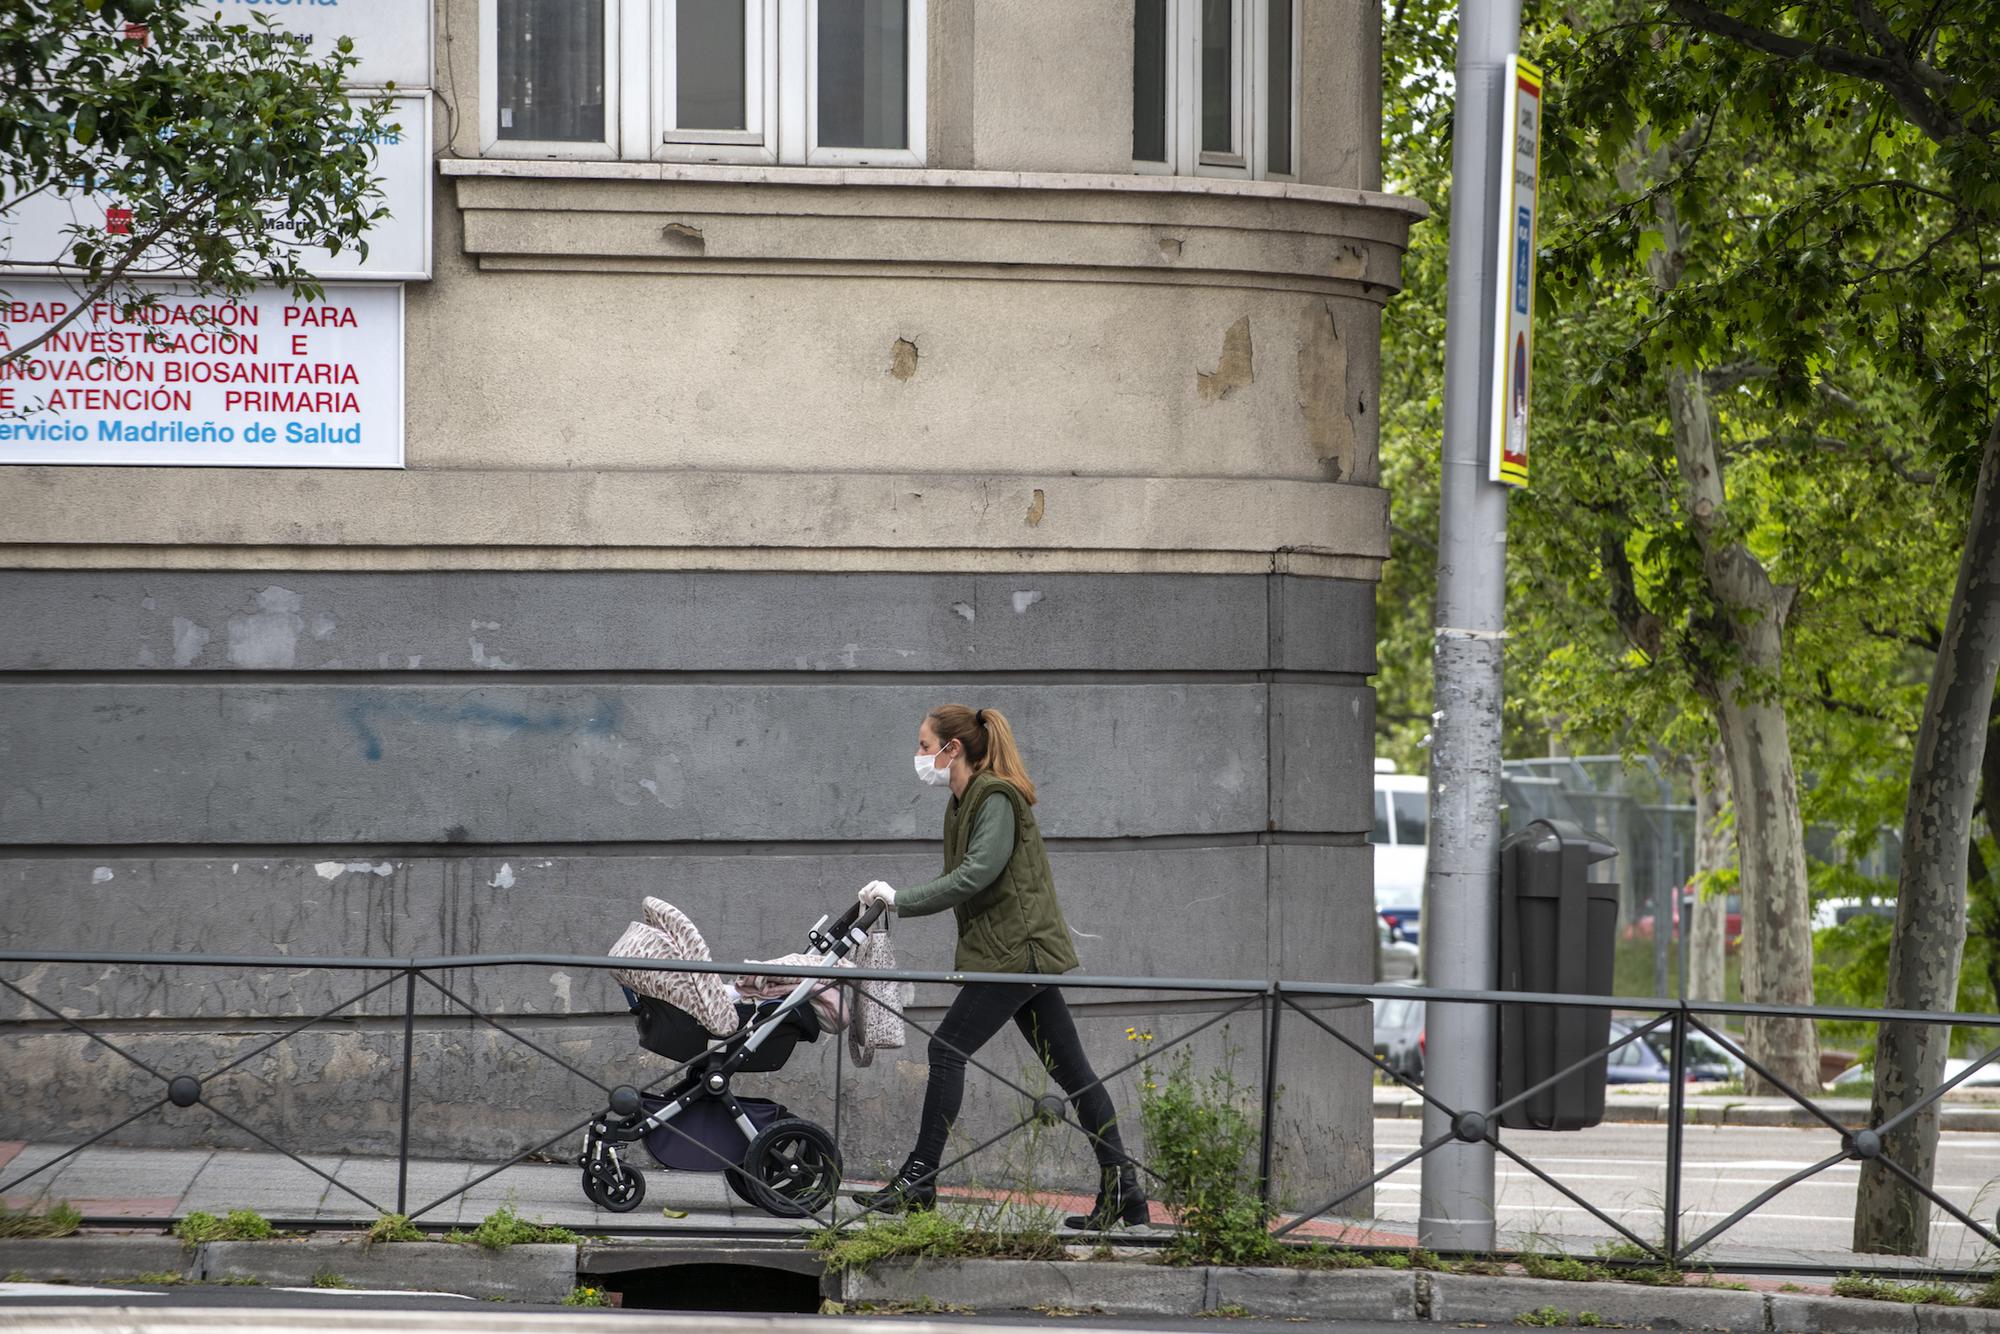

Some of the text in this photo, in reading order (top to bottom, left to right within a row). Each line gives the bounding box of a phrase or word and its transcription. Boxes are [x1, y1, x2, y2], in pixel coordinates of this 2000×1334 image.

[93, 299, 258, 327] FUNDACIÓN
[284, 306, 358, 328] PARA
[292, 335, 308, 355] E
[165, 361, 360, 385] BIOSANITARIA
[48, 385, 192, 411] ATENCIÓN
[225, 391, 361, 413] PRIMARIA
[0, 420, 361, 444] ervicio Madrileño de Salud
